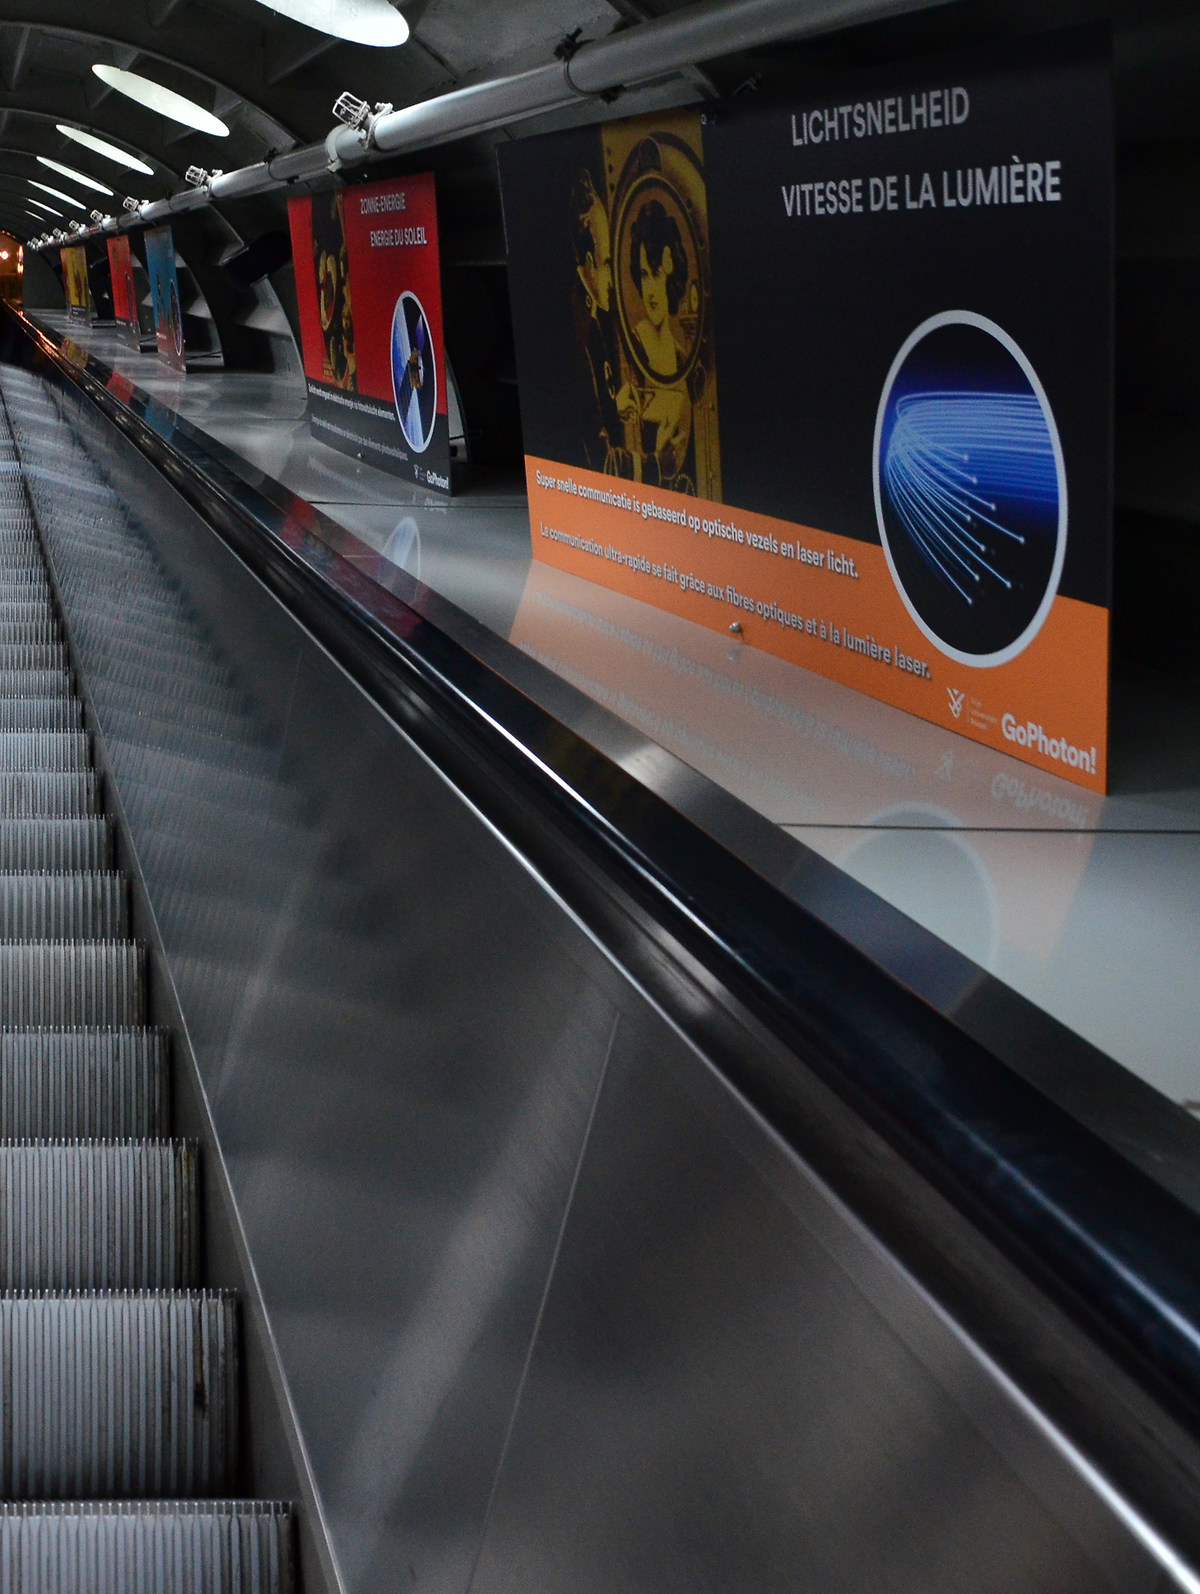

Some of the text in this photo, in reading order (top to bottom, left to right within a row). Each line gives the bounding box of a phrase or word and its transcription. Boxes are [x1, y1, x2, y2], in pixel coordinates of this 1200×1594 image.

[791, 86, 970, 147] LICHTSNELHEID
[360, 192, 406, 215] ZONNE-ENERGIE
[781, 155, 1062, 217] VITESSE DE LA LUMIÈRE
[370, 226, 428, 247] ENERGIE DU SOLEIL
[536, 469, 860, 579] Super snelle communicatie is gebaseerd op optische vezels en laser licht.
[540, 522, 931, 679] La communication ultra-rapide se fait grâce aux fibres optiques et à la lumière laser.
[1001, 712, 1097, 775] GoPhoton!
